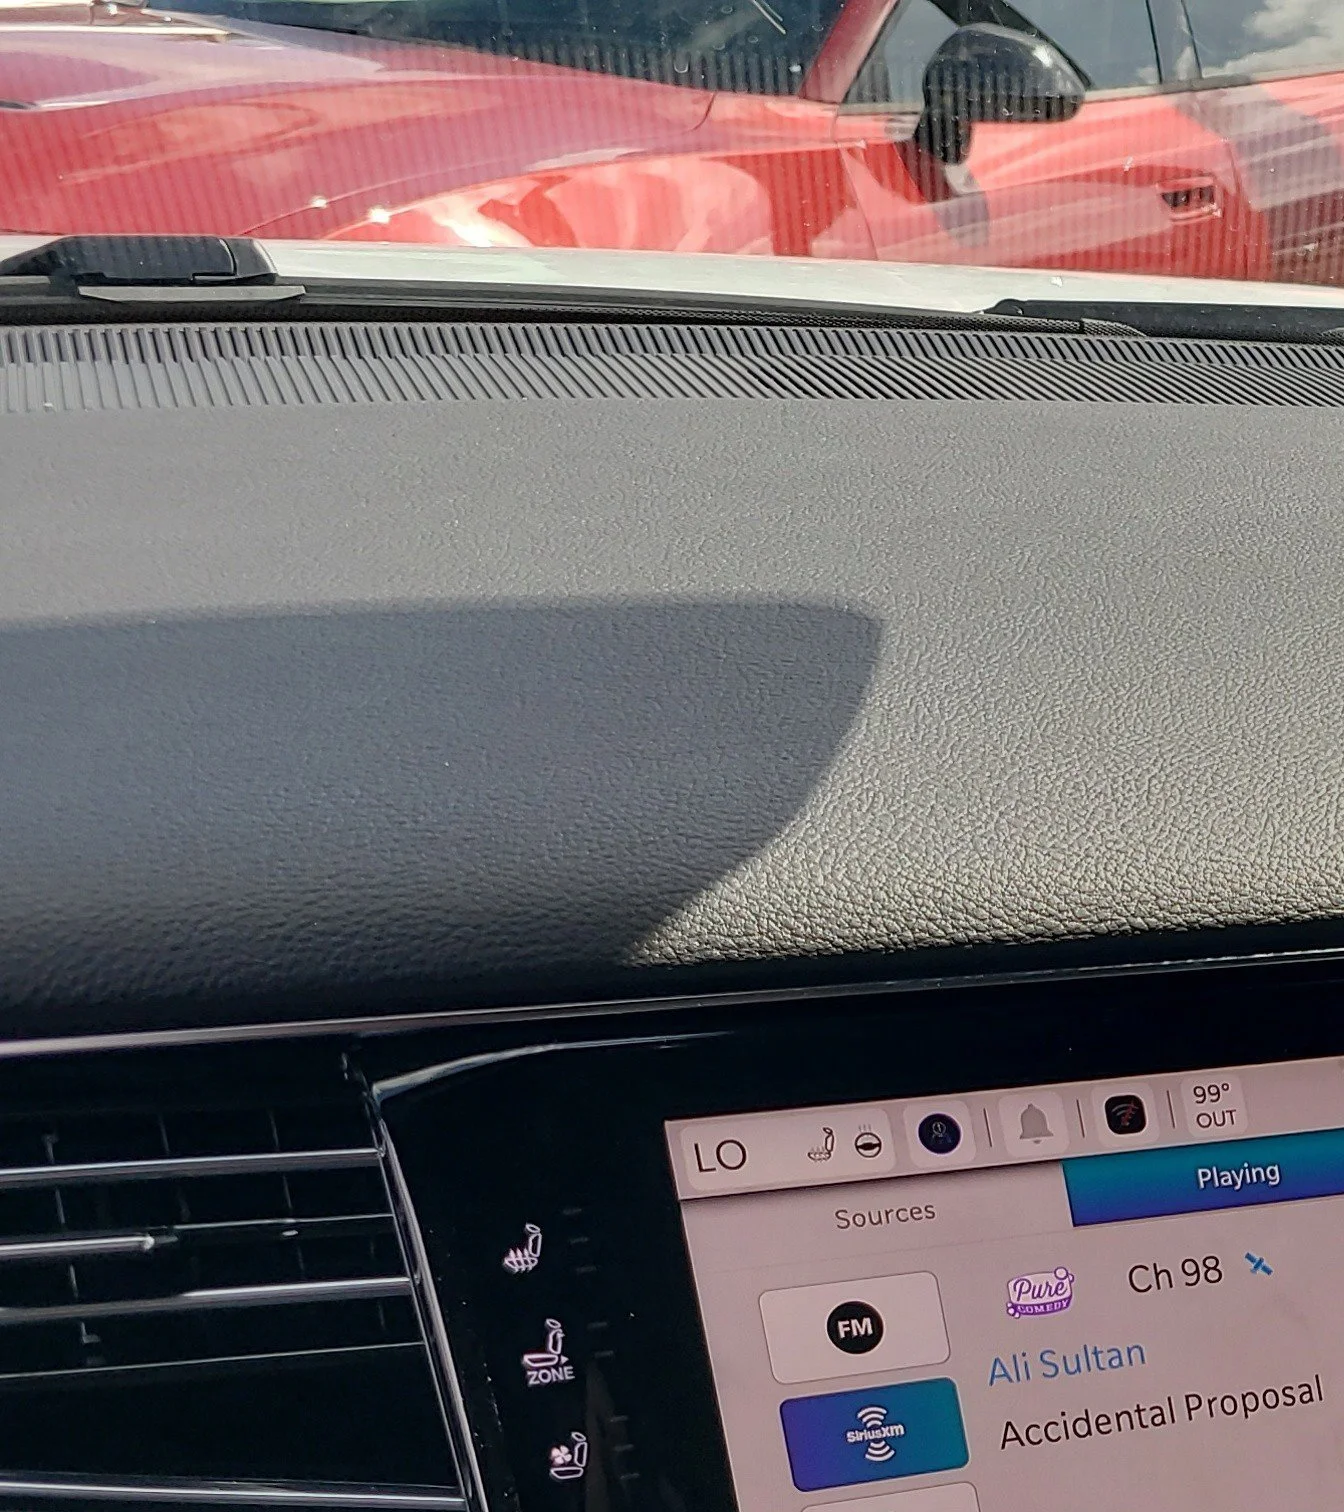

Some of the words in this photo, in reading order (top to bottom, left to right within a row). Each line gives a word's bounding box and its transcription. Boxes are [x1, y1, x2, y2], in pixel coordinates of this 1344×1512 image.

[1196, 1108, 1238, 1129] OUT
[695, 1138, 748, 1174] LO
[1196, 1161, 1282, 1191] Playing
[834, 1201, 937, 1231] Sources
[1013, 1278, 1068, 1301] Pure
[1127, 1263, 1174, 1295] Ch
[1181, 1256, 1224, 1287] 98
[1017, 1299, 1069, 1314] COMEDY
[836, 1318, 874, 1339] FM
[527, 1365, 576, 1387] ZONE
[987, 1352, 1032, 1387] Ali
[1040, 1340, 1147, 1379] Sultan
[1000, 1398, 1177, 1450] Accidental
[1185, 1374, 1326, 1423] Proposal
